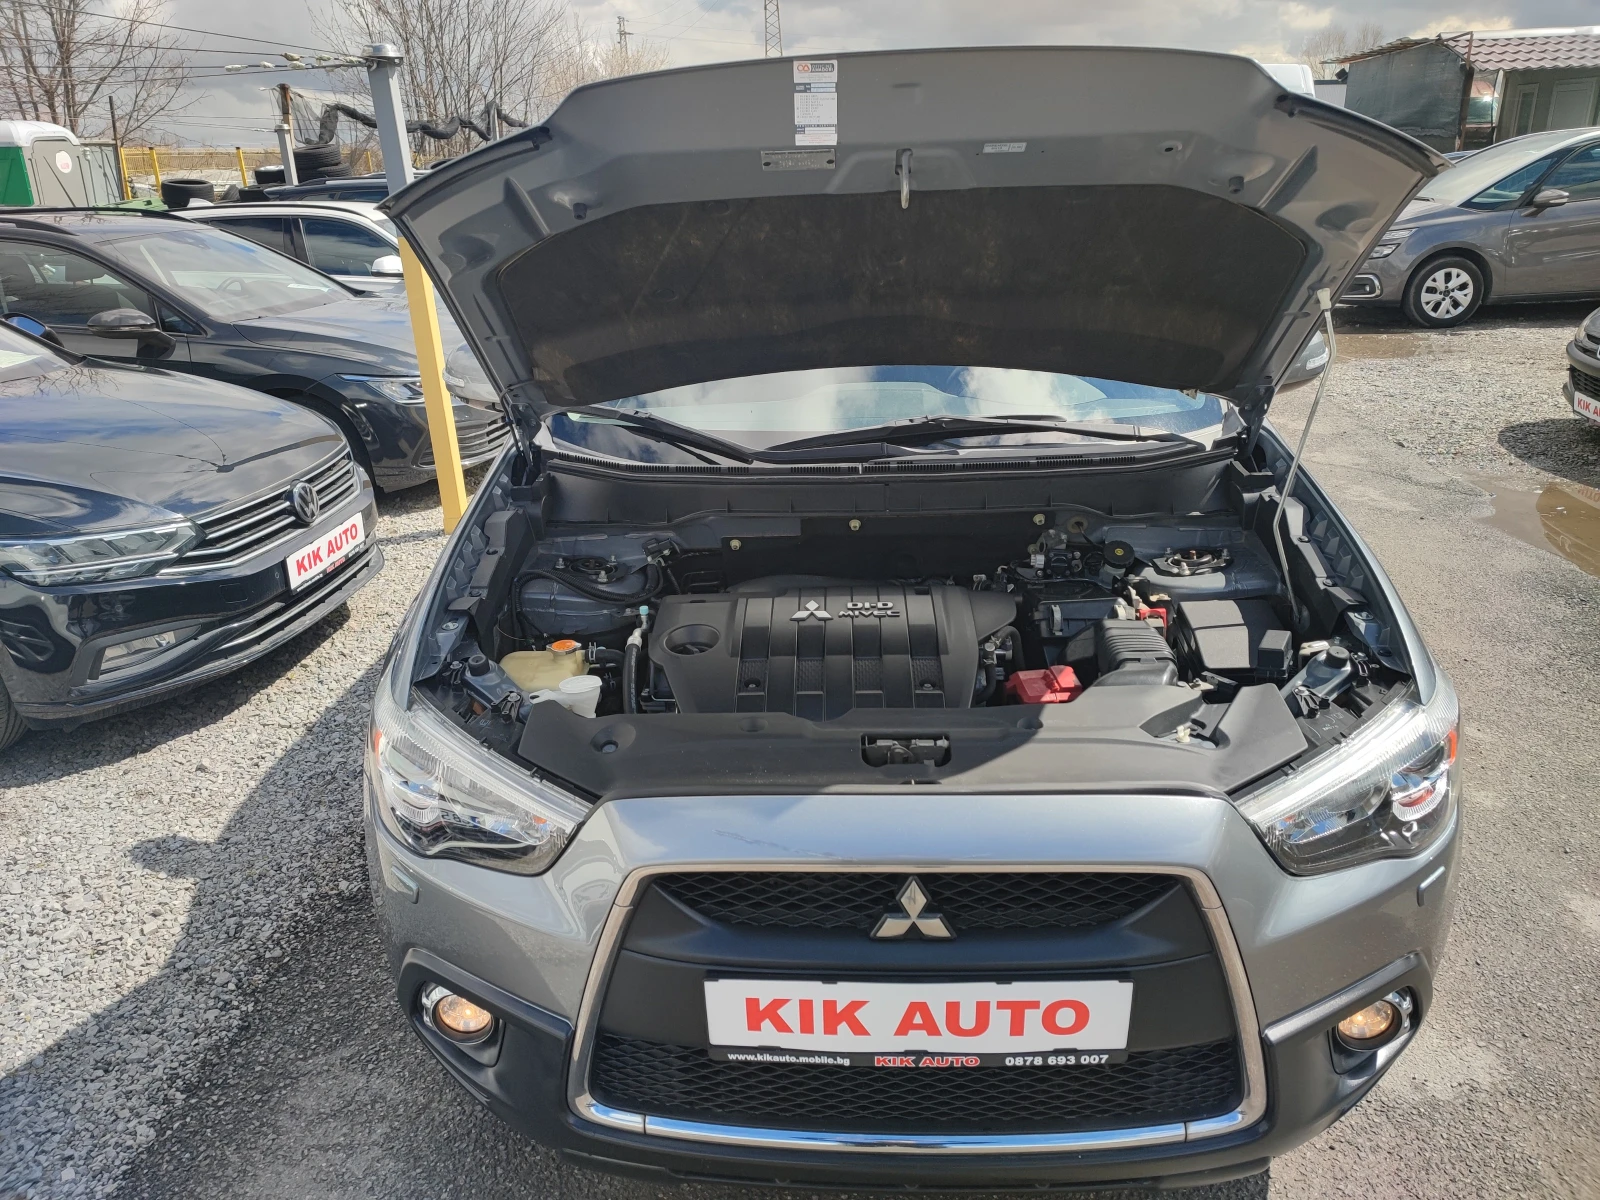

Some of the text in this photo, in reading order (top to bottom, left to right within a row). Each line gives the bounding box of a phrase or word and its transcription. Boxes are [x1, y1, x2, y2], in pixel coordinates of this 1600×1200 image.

[1577, 397, 1591, 412] KIK
[295, 546, 324, 577] KIK
[327, 523, 358, 558] AUTO
[847, 601, 894, 611] DI-D
[838, 610, 900, 618] MIVEC
[745, 997, 1090, 1038] KIK AUTO
[727, 1052, 1109, 1067] www.kikauto.mobile.bg KIK AUTO 0878 693 007
